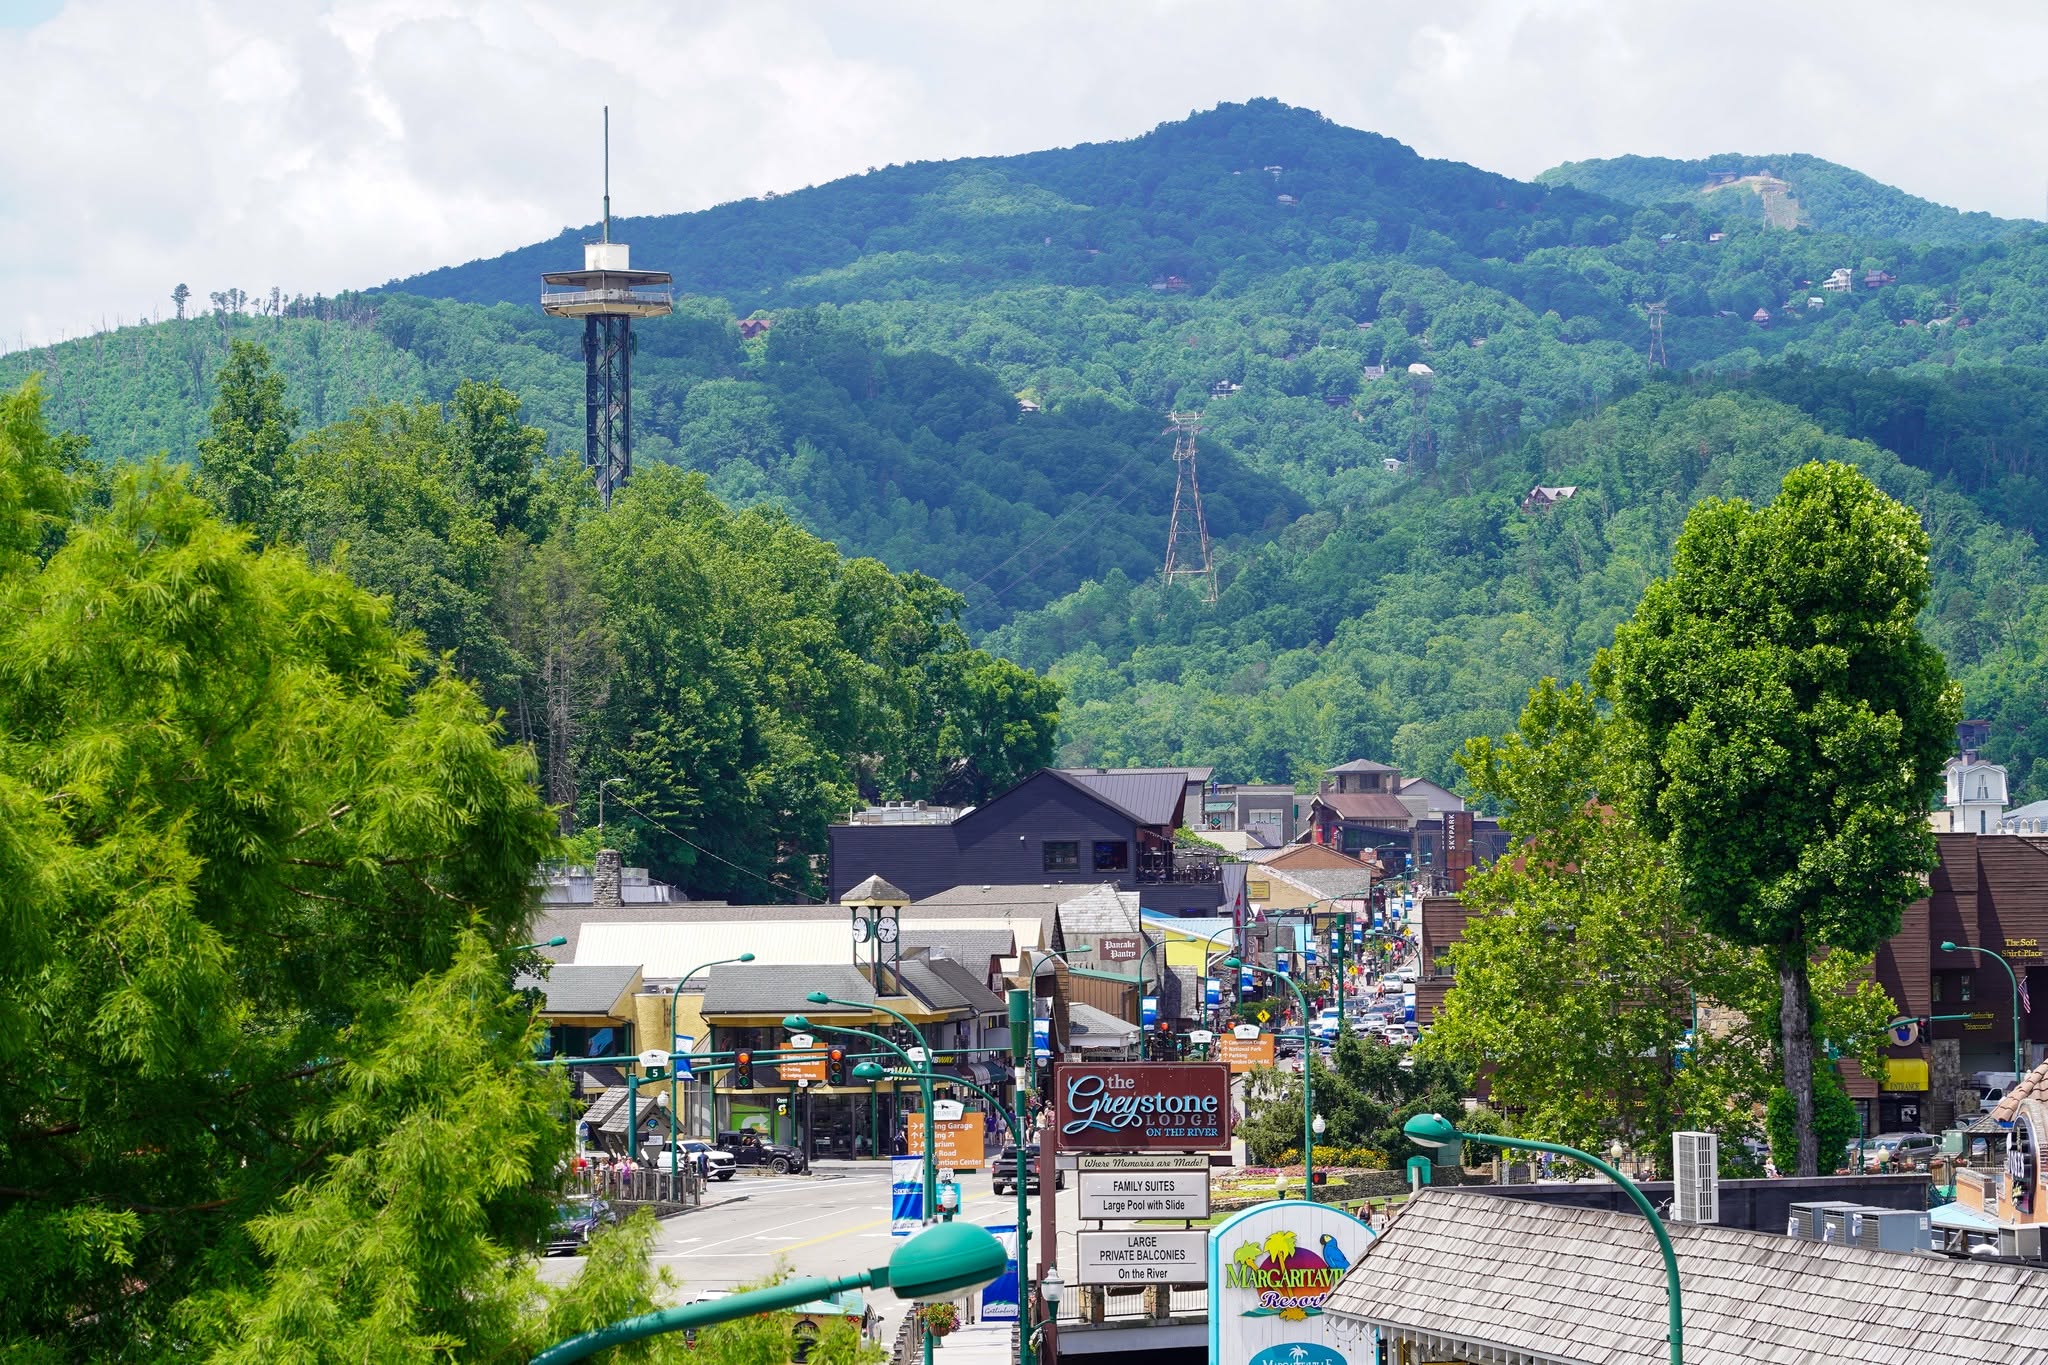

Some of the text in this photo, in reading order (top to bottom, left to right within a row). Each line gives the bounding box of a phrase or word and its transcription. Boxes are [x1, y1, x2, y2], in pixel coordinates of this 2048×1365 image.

[1104, 940, 1136, 949] Pancake
[2005, 938, 2037, 947] The Soft
[1110, 949, 1136, 959] Pantry
[2001, 949, 2043, 957] Shirt Place
[652, 1069, 658, 1077] 5
[1107, 1074, 1135, 1089] the
[1889, 1082, 1920, 1090] ENTRANCE
[1062, 1075, 1218, 1134] Greystone
[1146, 1114, 1217, 1126] LODGE
[948, 1122, 973, 1131] Garage
[1146, 1128, 1218, 1137] ON THE RIVER
[960, 1158, 982, 1166] Center
[1084, 1159, 1110, 1168] Where
[1113, 1159, 1154, 1168] Memories
[1174, 1158, 1203, 1167] Made!
[1113, 1180, 1175, 1192] FAMILY SUITES
[1103, 1199, 1185, 1213] Large Pool with Slide
[1128, 1237, 1157, 1248] LARGE
[1100, 1249, 1186, 1261] PRIVATE BALCONIES
[1118, 1268, 1168, 1279] On the River
[1259, 1290, 1327, 1308] Resort
[984, 1307, 1016, 1315] Gatlinburg
